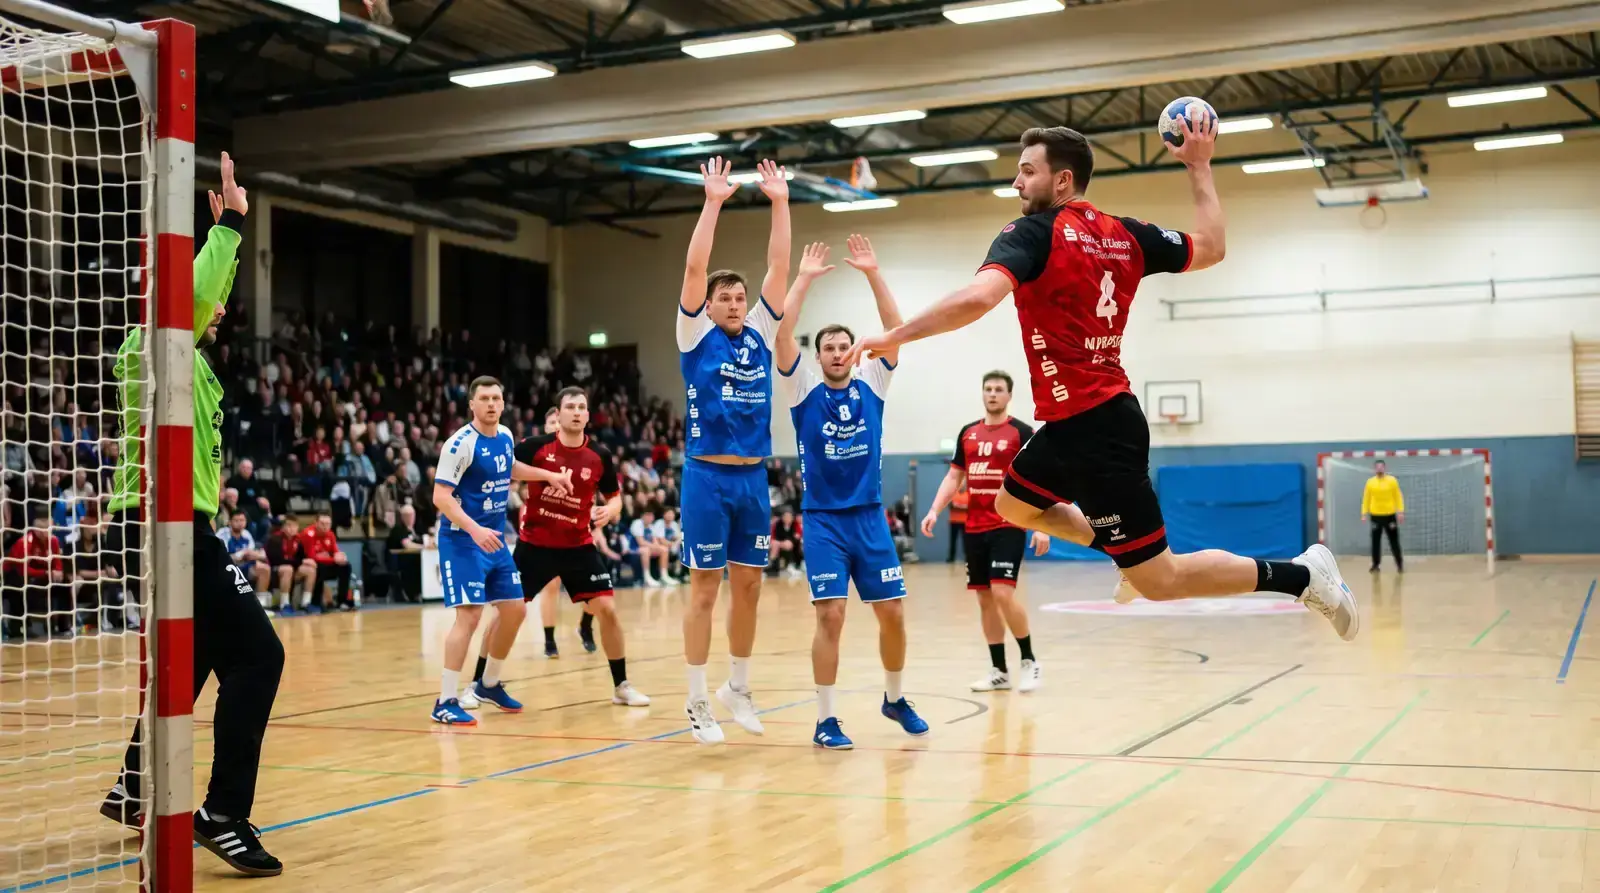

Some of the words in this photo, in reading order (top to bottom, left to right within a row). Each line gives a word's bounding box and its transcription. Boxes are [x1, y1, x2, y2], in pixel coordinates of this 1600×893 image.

[1096, 270, 1118, 329] 4
[838, 404, 852, 421] 8
[978, 441, 993, 457] 10
[493, 453, 508, 474] 12
